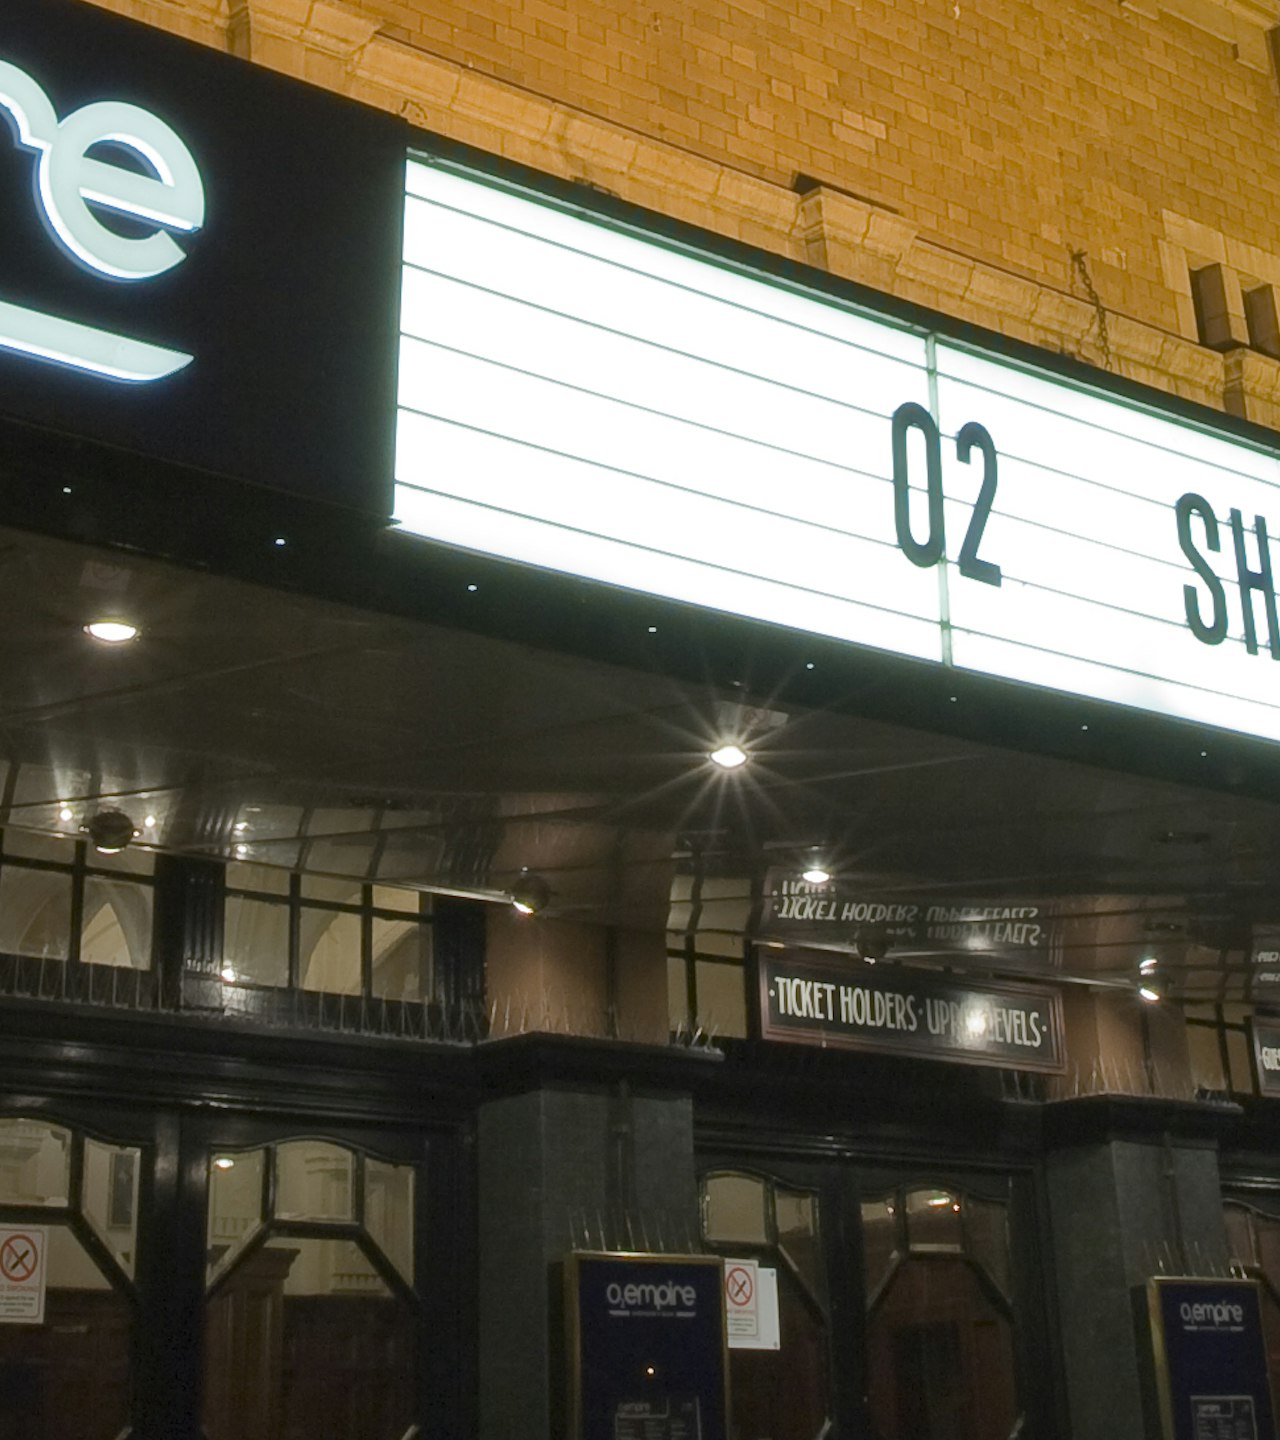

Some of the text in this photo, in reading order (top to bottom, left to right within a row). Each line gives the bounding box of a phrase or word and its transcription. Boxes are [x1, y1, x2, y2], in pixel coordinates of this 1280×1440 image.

[774, 976, 836, 1021] TICKET
[840, 986, 918, 1032] HOLDERS
[624, 1280, 696, 1311] empire
